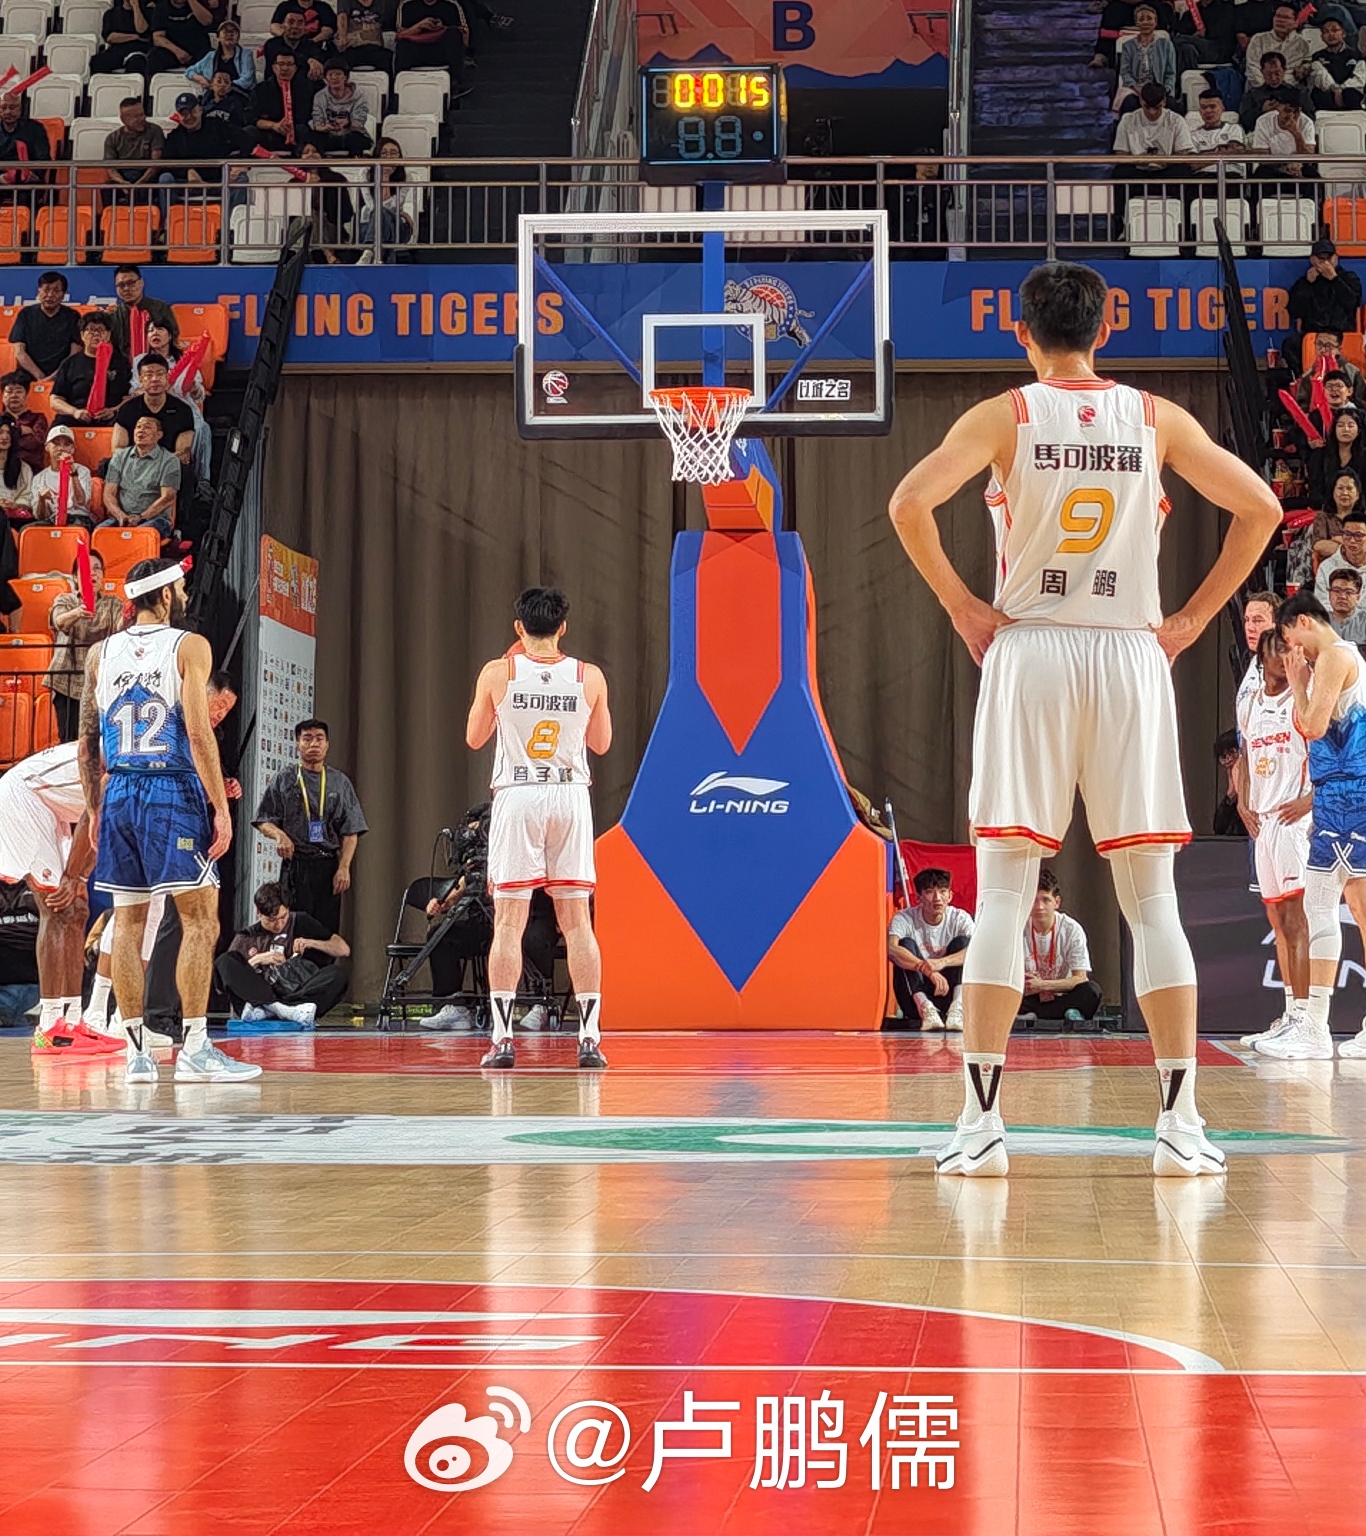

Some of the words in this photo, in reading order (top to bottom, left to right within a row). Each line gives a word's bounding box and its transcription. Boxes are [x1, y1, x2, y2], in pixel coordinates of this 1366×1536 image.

[772, 0, 816, 52] B
[217, 293, 375, 337] FLING
[971, 288, 1131, 332] FLG
[1034, 443, 1143, 473] 馬可波羅
[1056, 487, 1115, 554] 9
[512, 692, 578, 713] 馬可波羅
[109, 700, 170, 755] 12
[526, 719, 562, 760] 8
[689, 798, 791, 816] LI-NING
